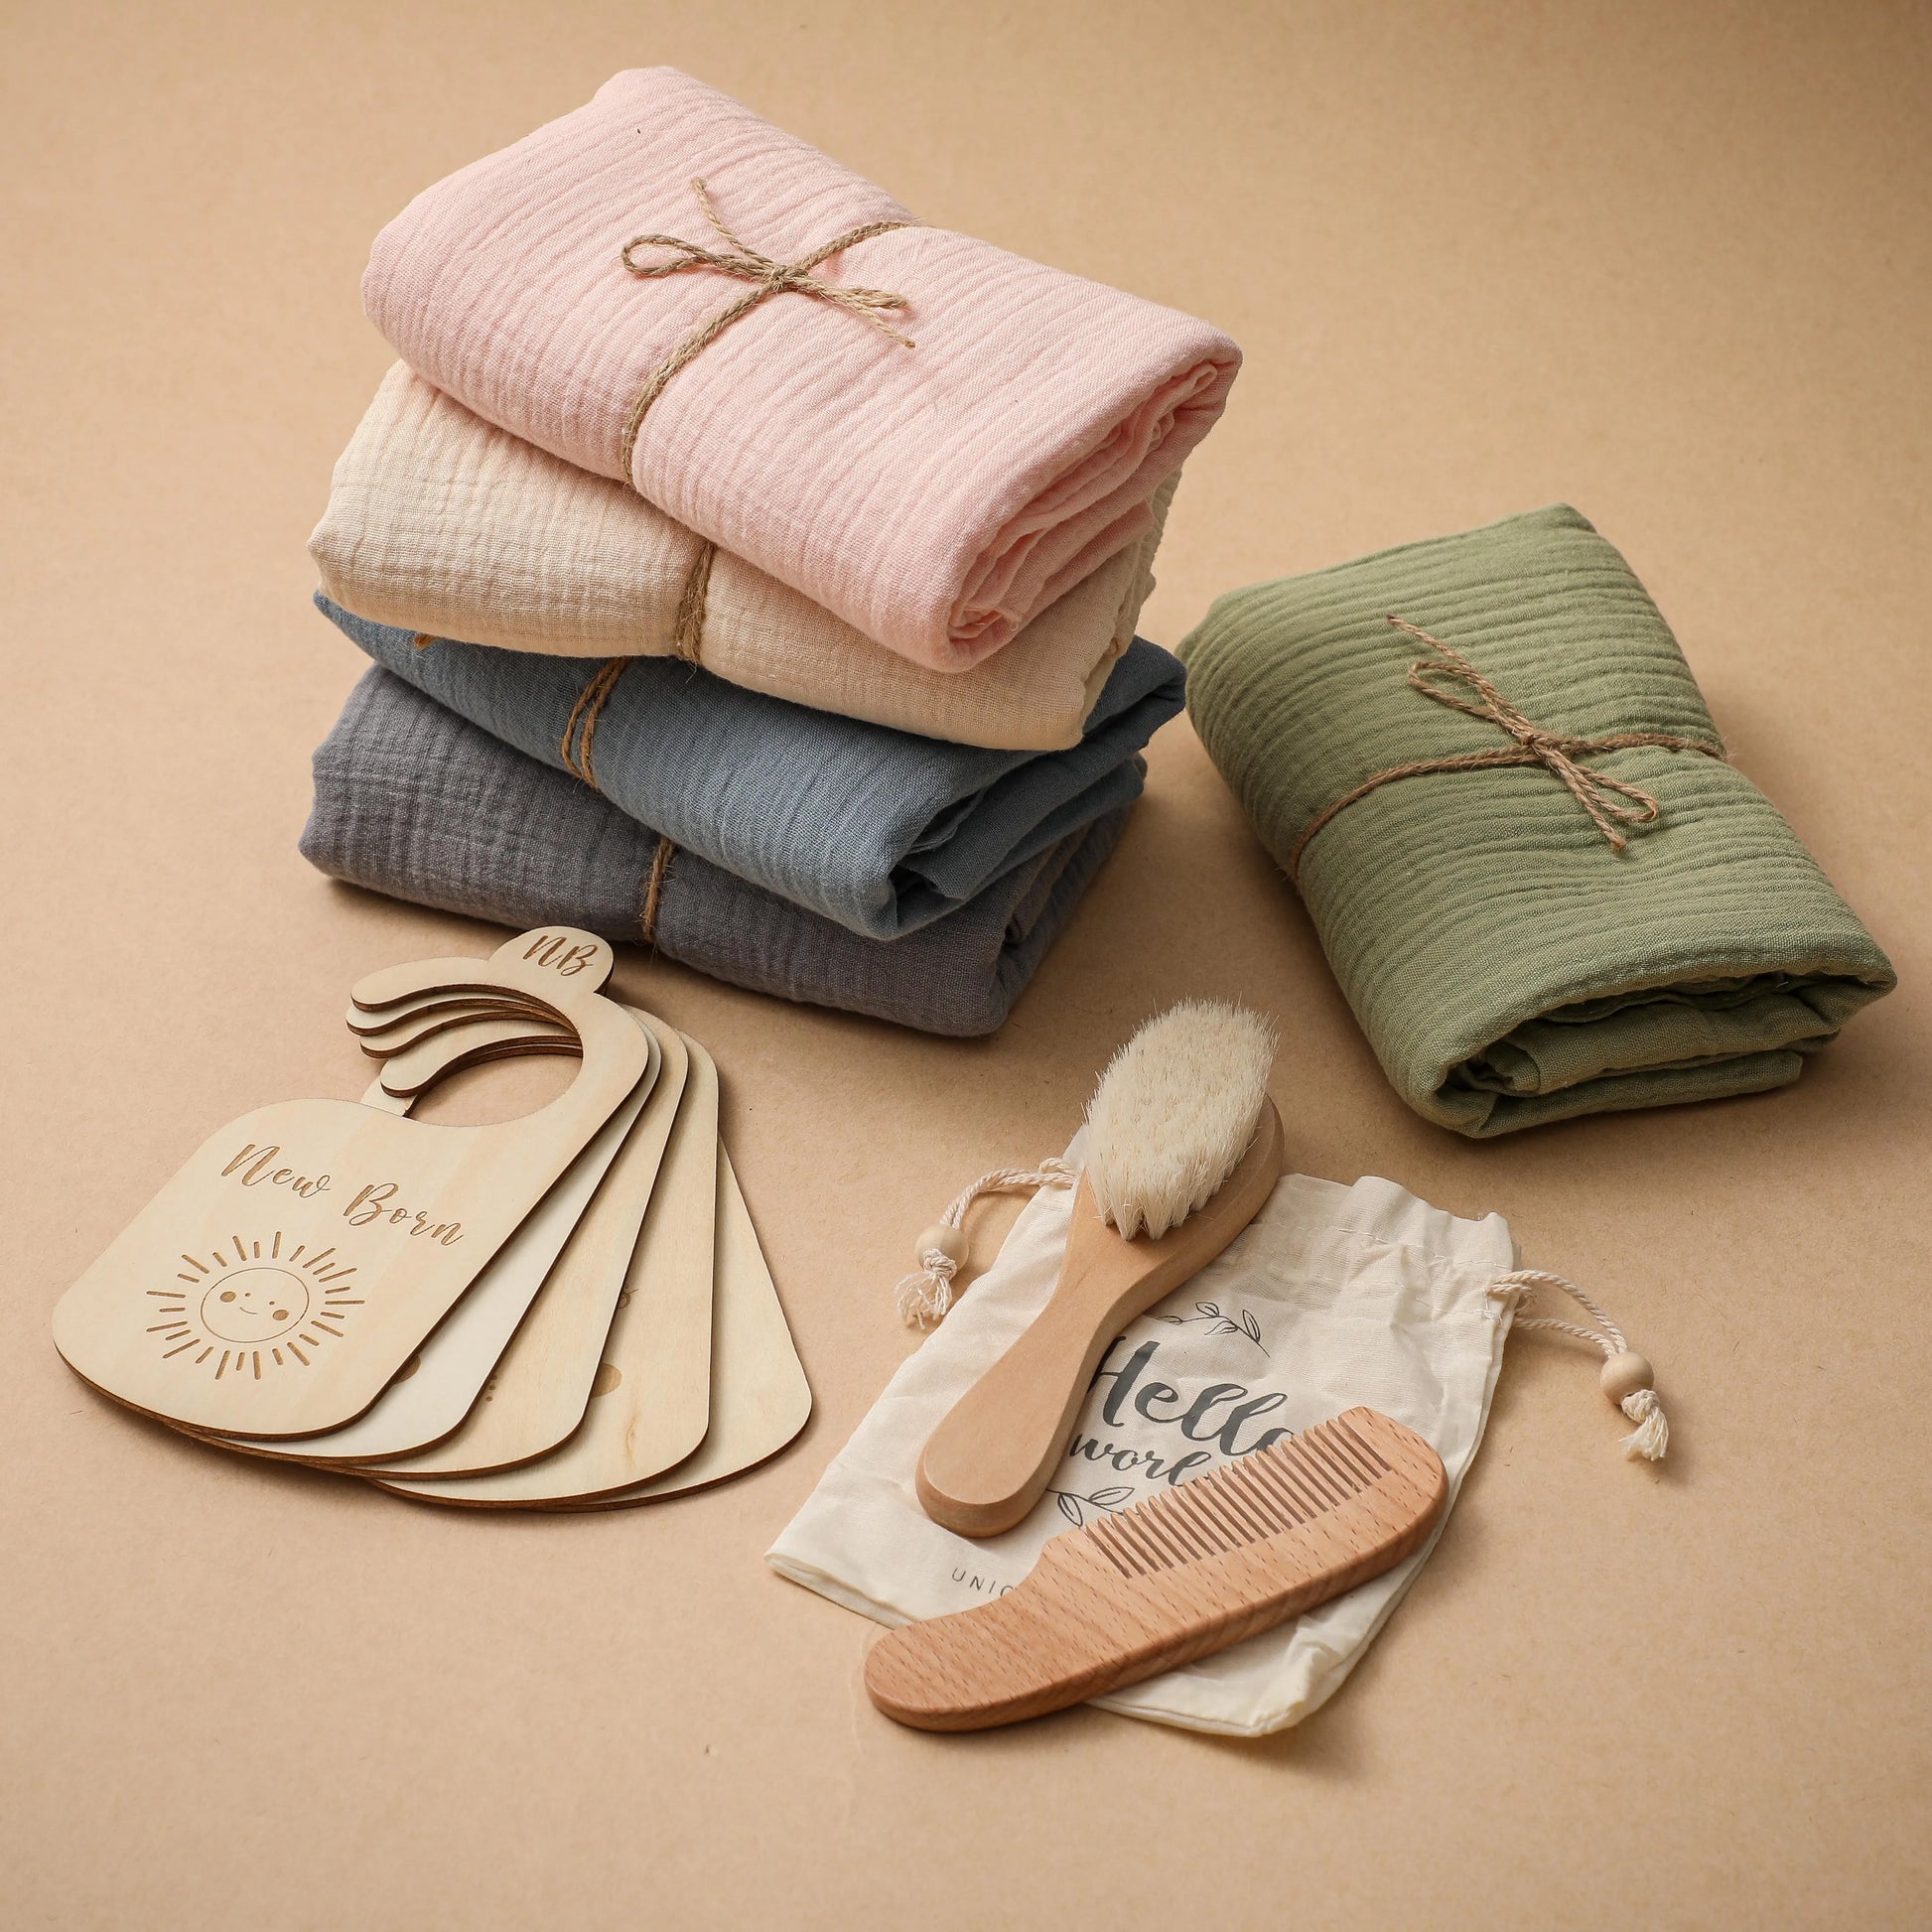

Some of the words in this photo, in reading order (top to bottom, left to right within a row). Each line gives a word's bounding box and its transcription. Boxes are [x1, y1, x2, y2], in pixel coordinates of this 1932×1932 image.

[522, 935, 598, 976] NB
[220, 1143, 331, 1198] New
[343, 1182, 465, 1246] Born
[1069, 1433, 1212, 1487] worl
